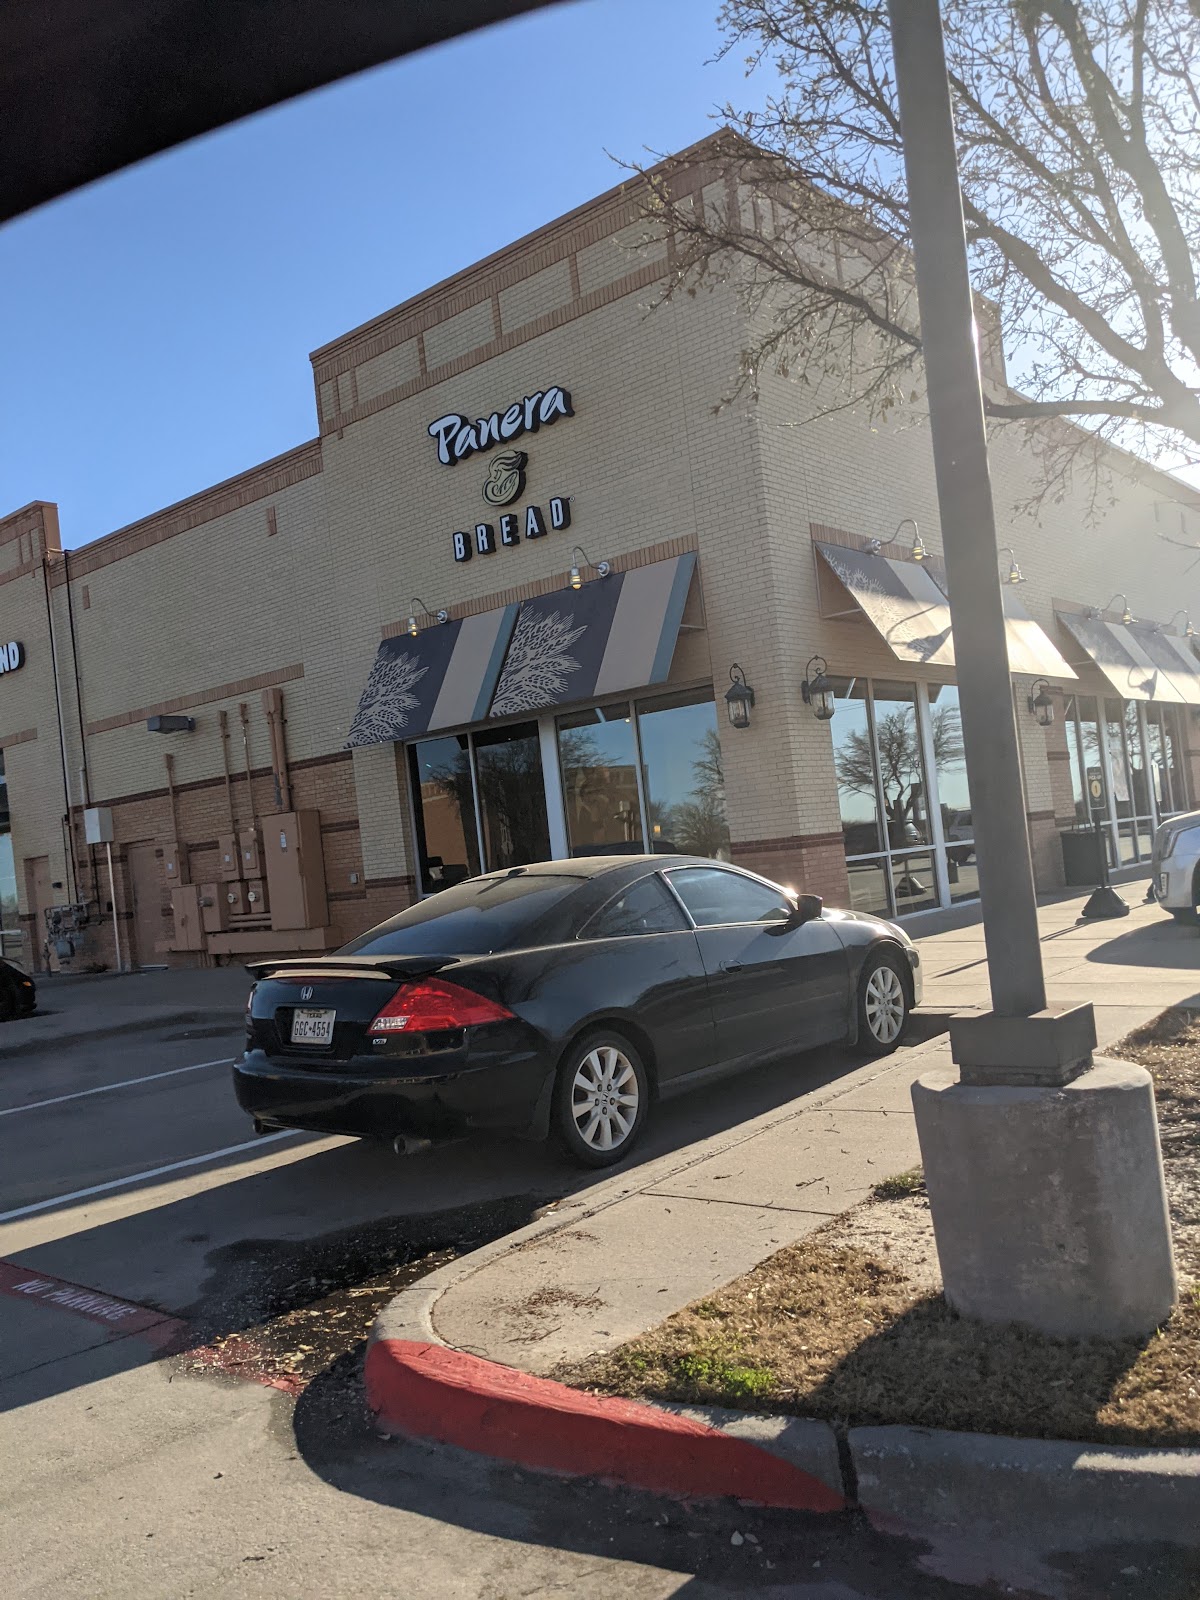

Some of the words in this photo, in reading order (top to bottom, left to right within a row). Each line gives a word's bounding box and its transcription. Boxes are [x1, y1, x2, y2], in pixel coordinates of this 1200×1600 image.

[428, 386, 574, 466] Panera
[453, 497, 571, 562] BREAD
[11, 1279, 54, 1294] NO
[41, 1288, 138, 1320] PARKING
